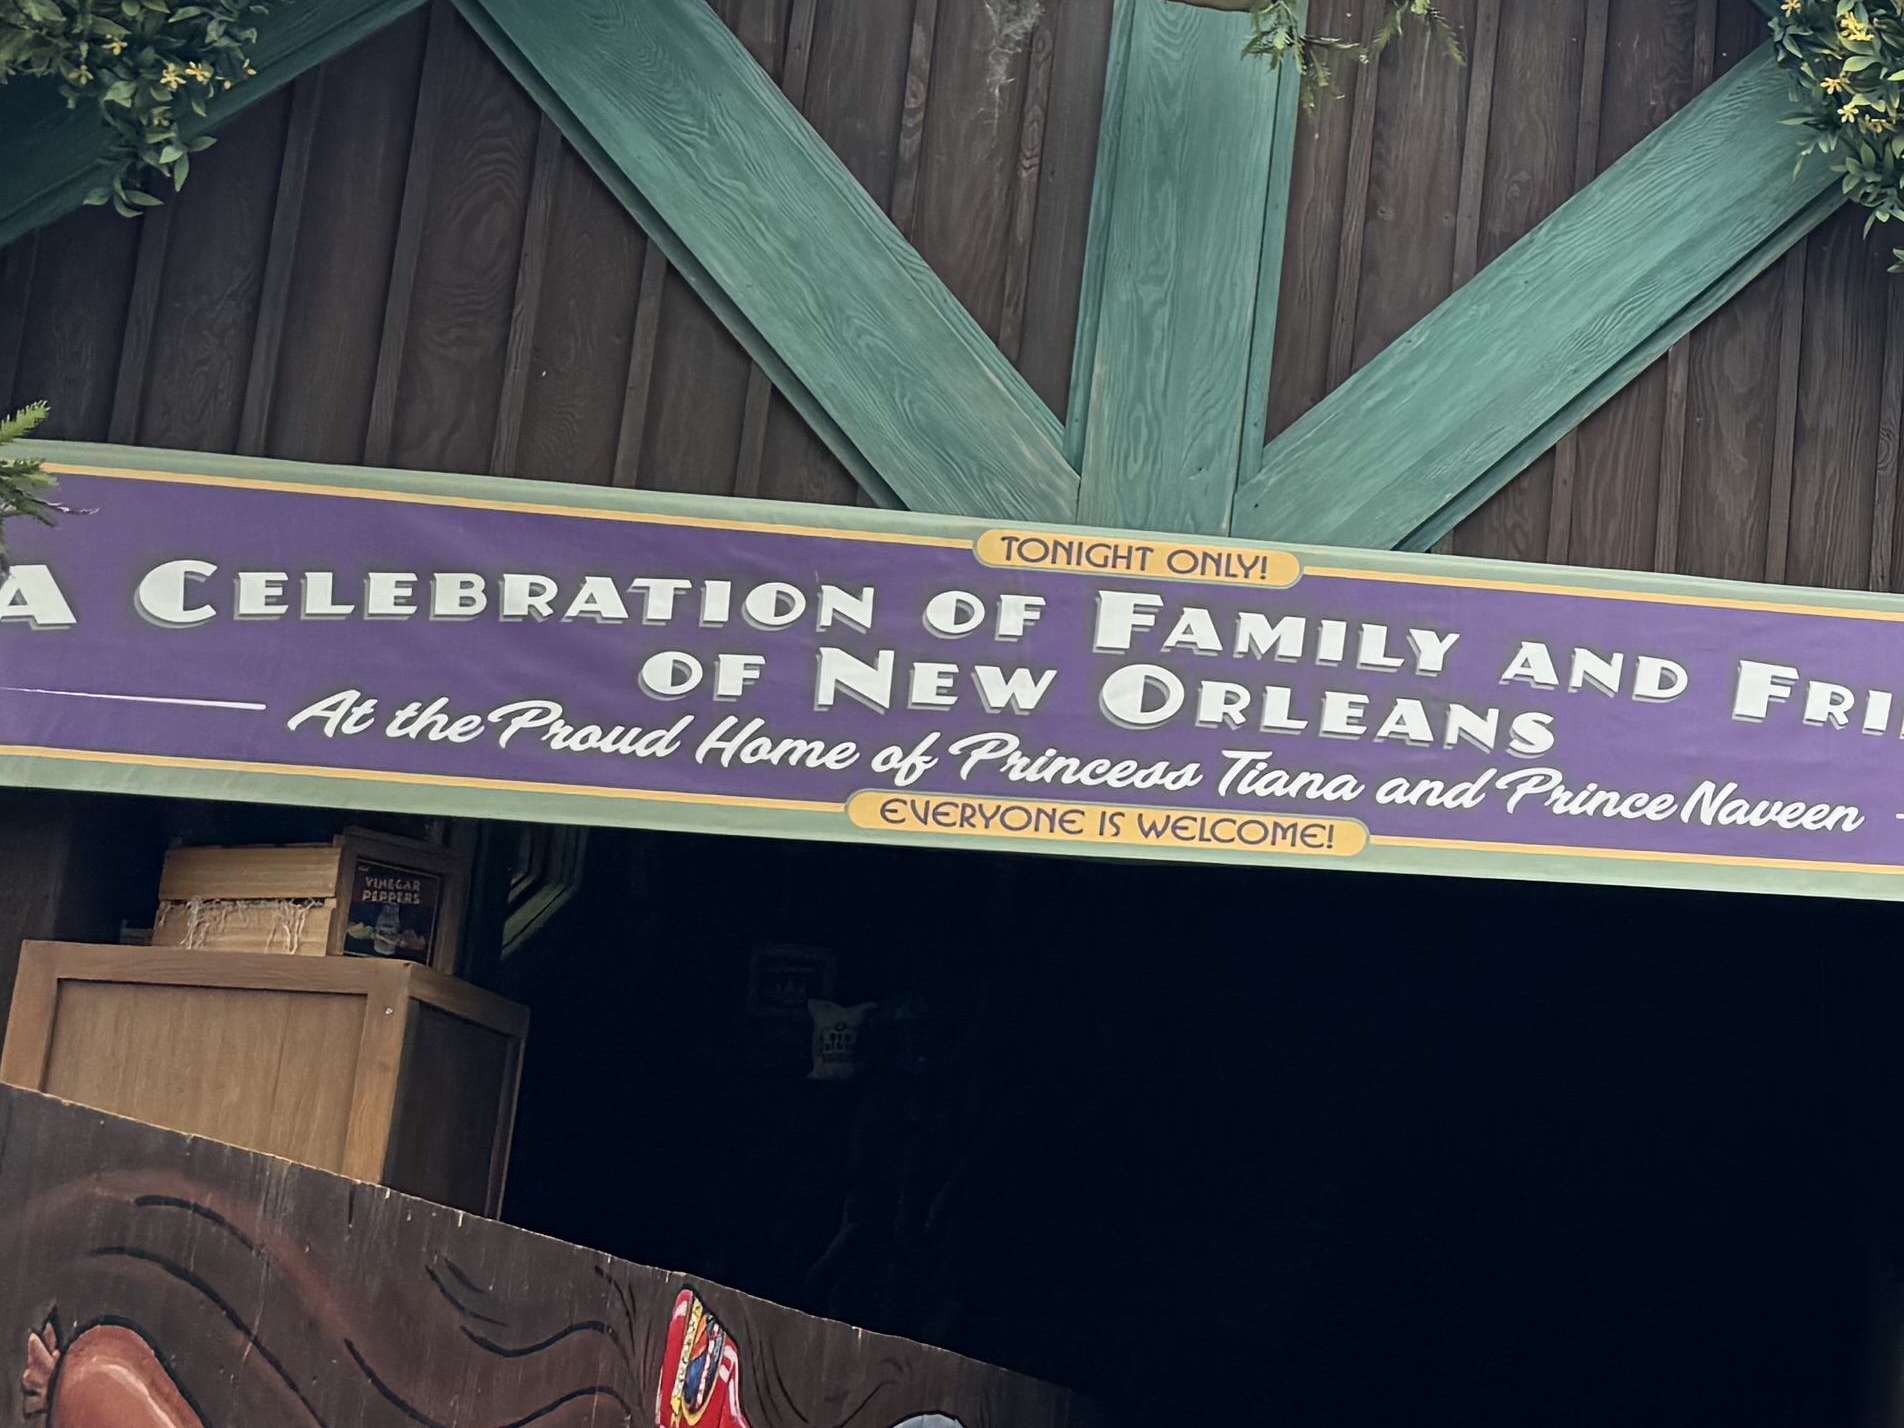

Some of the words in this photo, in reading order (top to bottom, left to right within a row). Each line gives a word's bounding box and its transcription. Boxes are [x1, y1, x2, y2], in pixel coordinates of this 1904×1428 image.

[1001, 536, 1154, 573] TONIGHT
[1166, 549, 1268, 580] ONLY!
[0, 565, 77, 629] A
[134, 560, 874, 633] CELEBRATION
[923, 590, 1046, 642] OF
[1094, 590, 1459, 675] FAMILY
[1500, 641, 1689, 703] AND
[639, 651, 766, 701] OF
[814, 647, 1056, 715] NEW
[1100, 663, 1555, 762] ORLEANS
[287, 689, 375, 738] At
[386, 695, 484, 743] the
[487, 699, 694, 758] Proud
[694, 716, 860, 771] Home
[872, 731, 942, 787] of
[948, 735, 1203, 790] Princess
[1216, 749, 1366, 801] Tiana
[1375, 768, 1496, 810] and
[1494, 767, 1677, 823] Prince
[1678, 780, 1866, 834] Naveen
[880, 798, 1085, 834] EVERYONE
[1099, 810, 1121, 837] IS
[1134, 814, 1335, 850] WELCOME!
[362, 889, 420, 905] PEPPERS
[365, 876, 420, 891] VINEGAR
